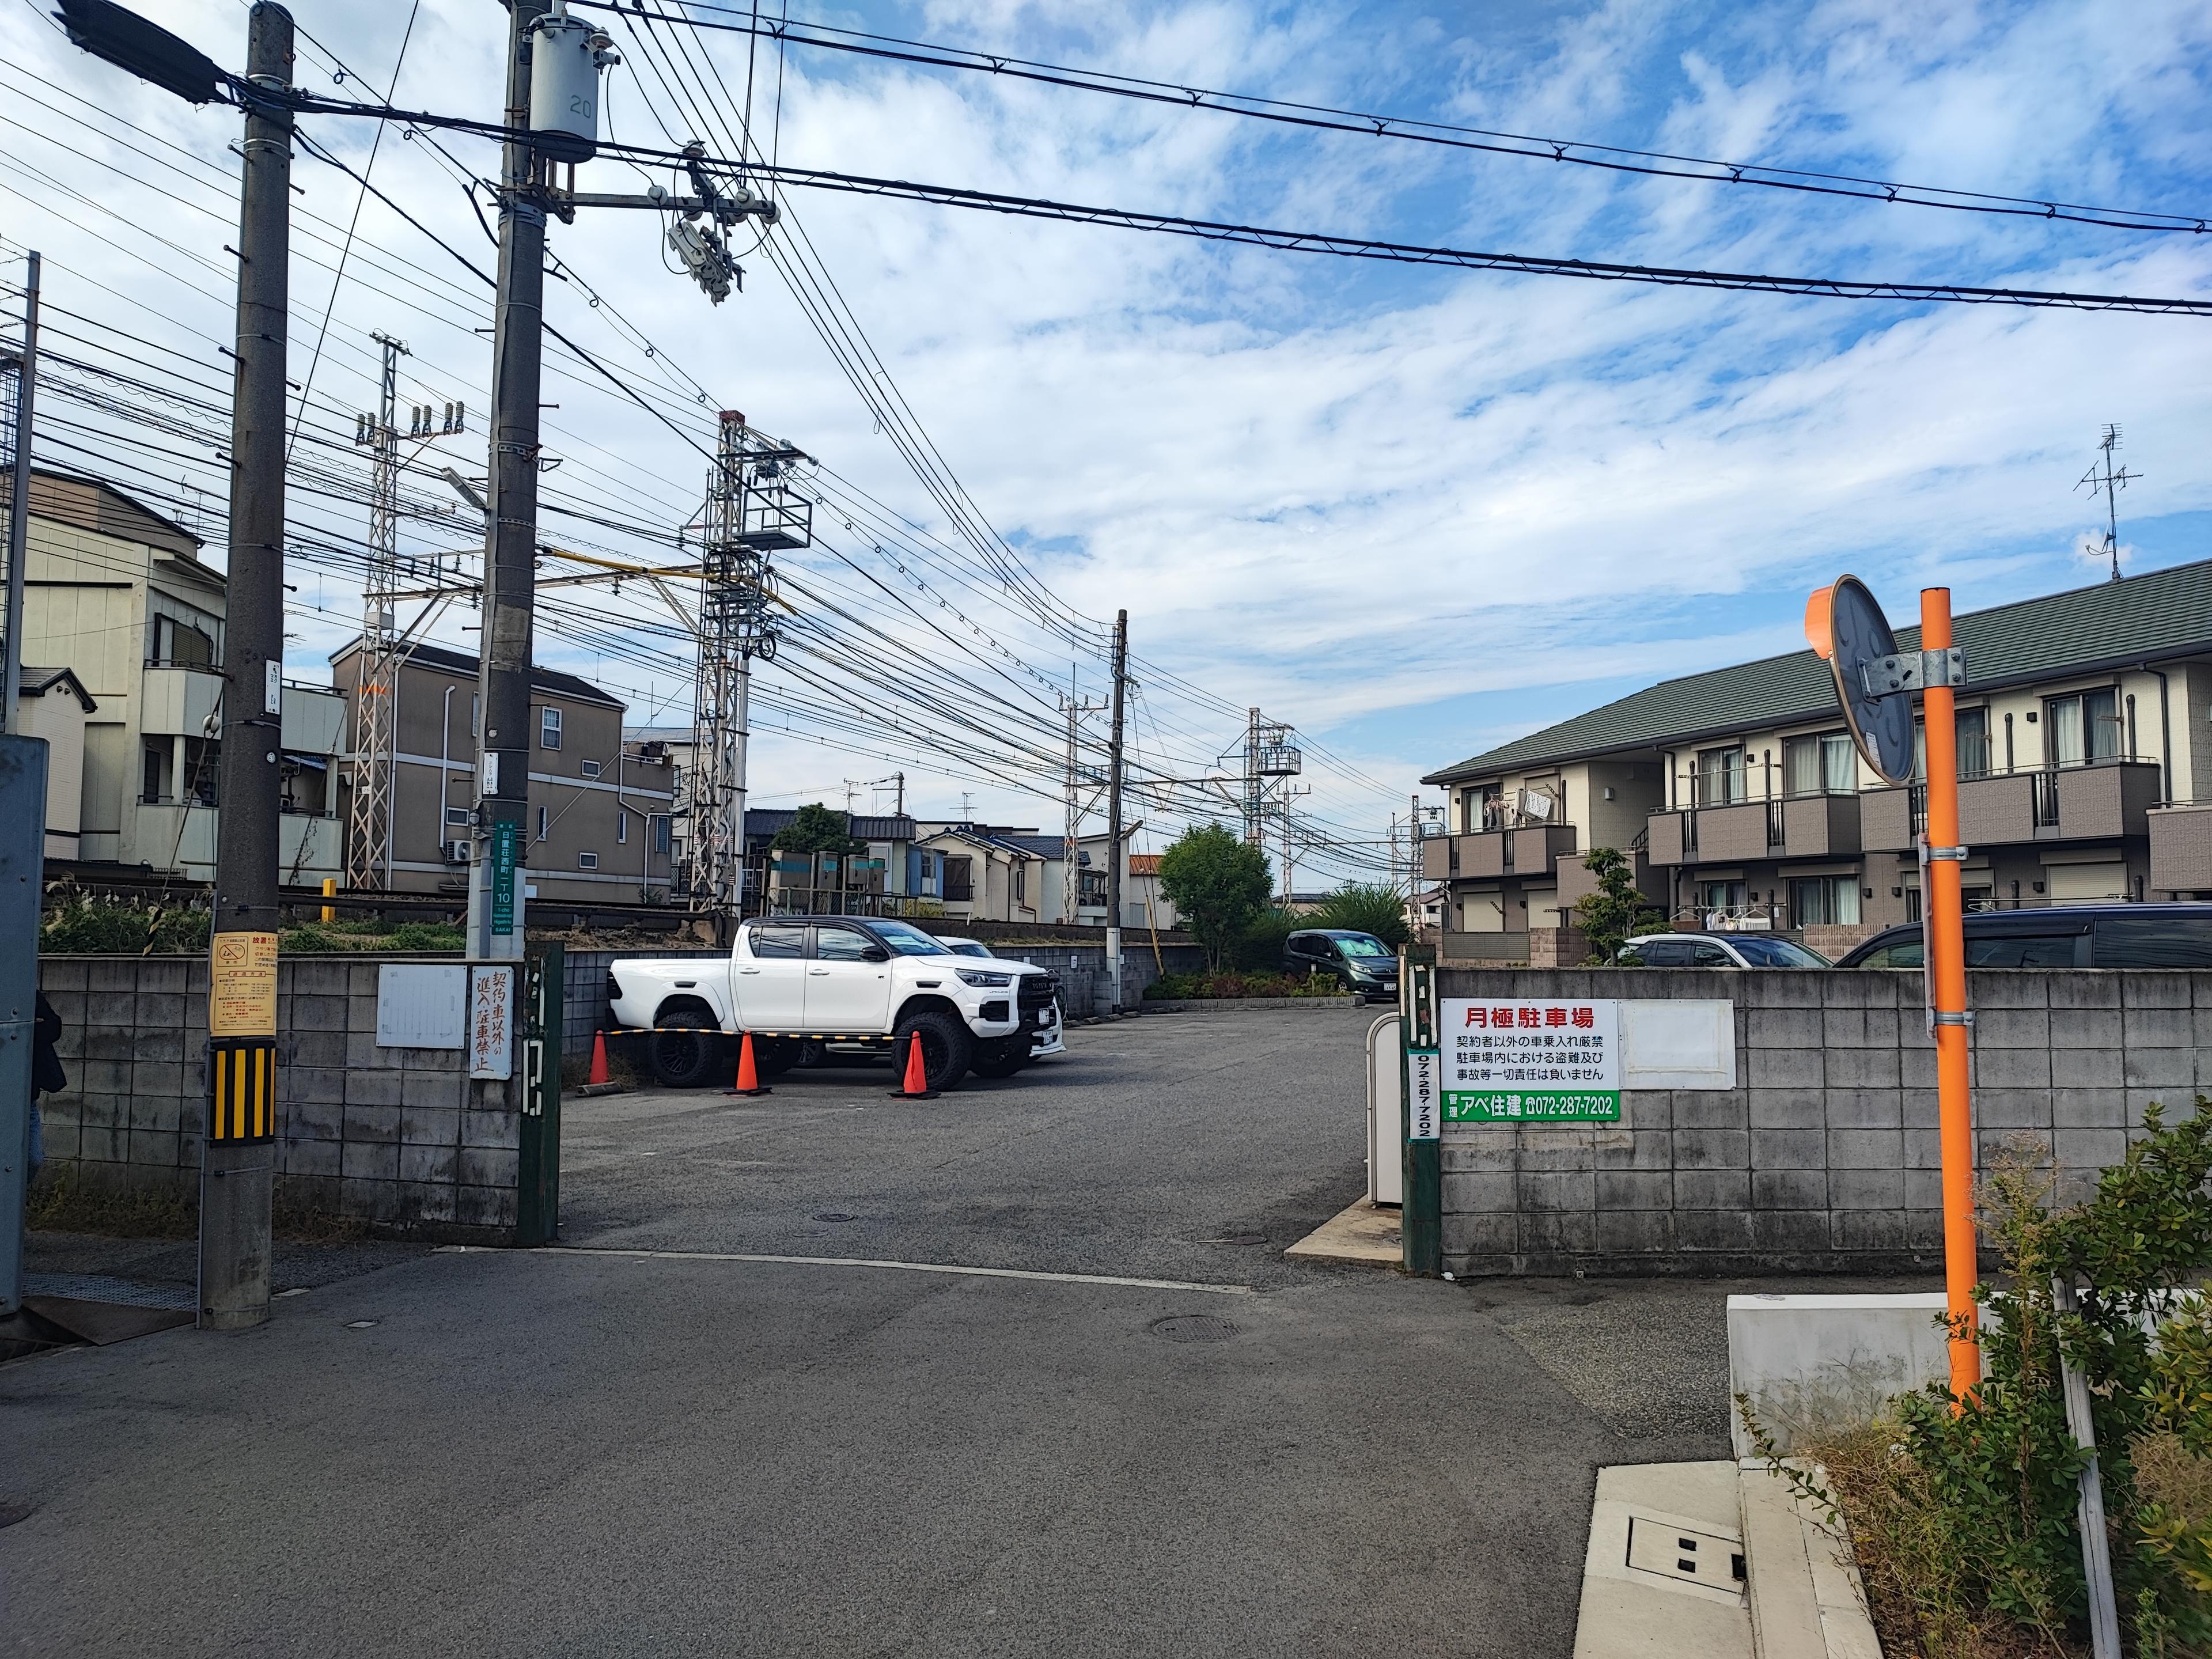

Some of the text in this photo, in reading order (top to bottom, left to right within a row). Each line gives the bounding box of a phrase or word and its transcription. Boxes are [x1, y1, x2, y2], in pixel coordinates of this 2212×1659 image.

[570, 94, 591, 119] 20
[497, 893, 510, 903] 10
[491, 971, 506, 1055] 契約車以外の
[1465, 1007, 1594, 1029] 月極駐車場
[1456, 1035, 1604, 1048] 契約者以外の車乗入れ厳禁
[1456, 1051, 1604, 1064] 駐車場内における盗難及び
[1456, 1068, 1604, 1081] 事故等一切責任は負いません
[1418, 1055, 1431, 1137] 072-287-7202
[1448, 1093, 1613, 1118] 管理 アベ住建 072-287-7202
